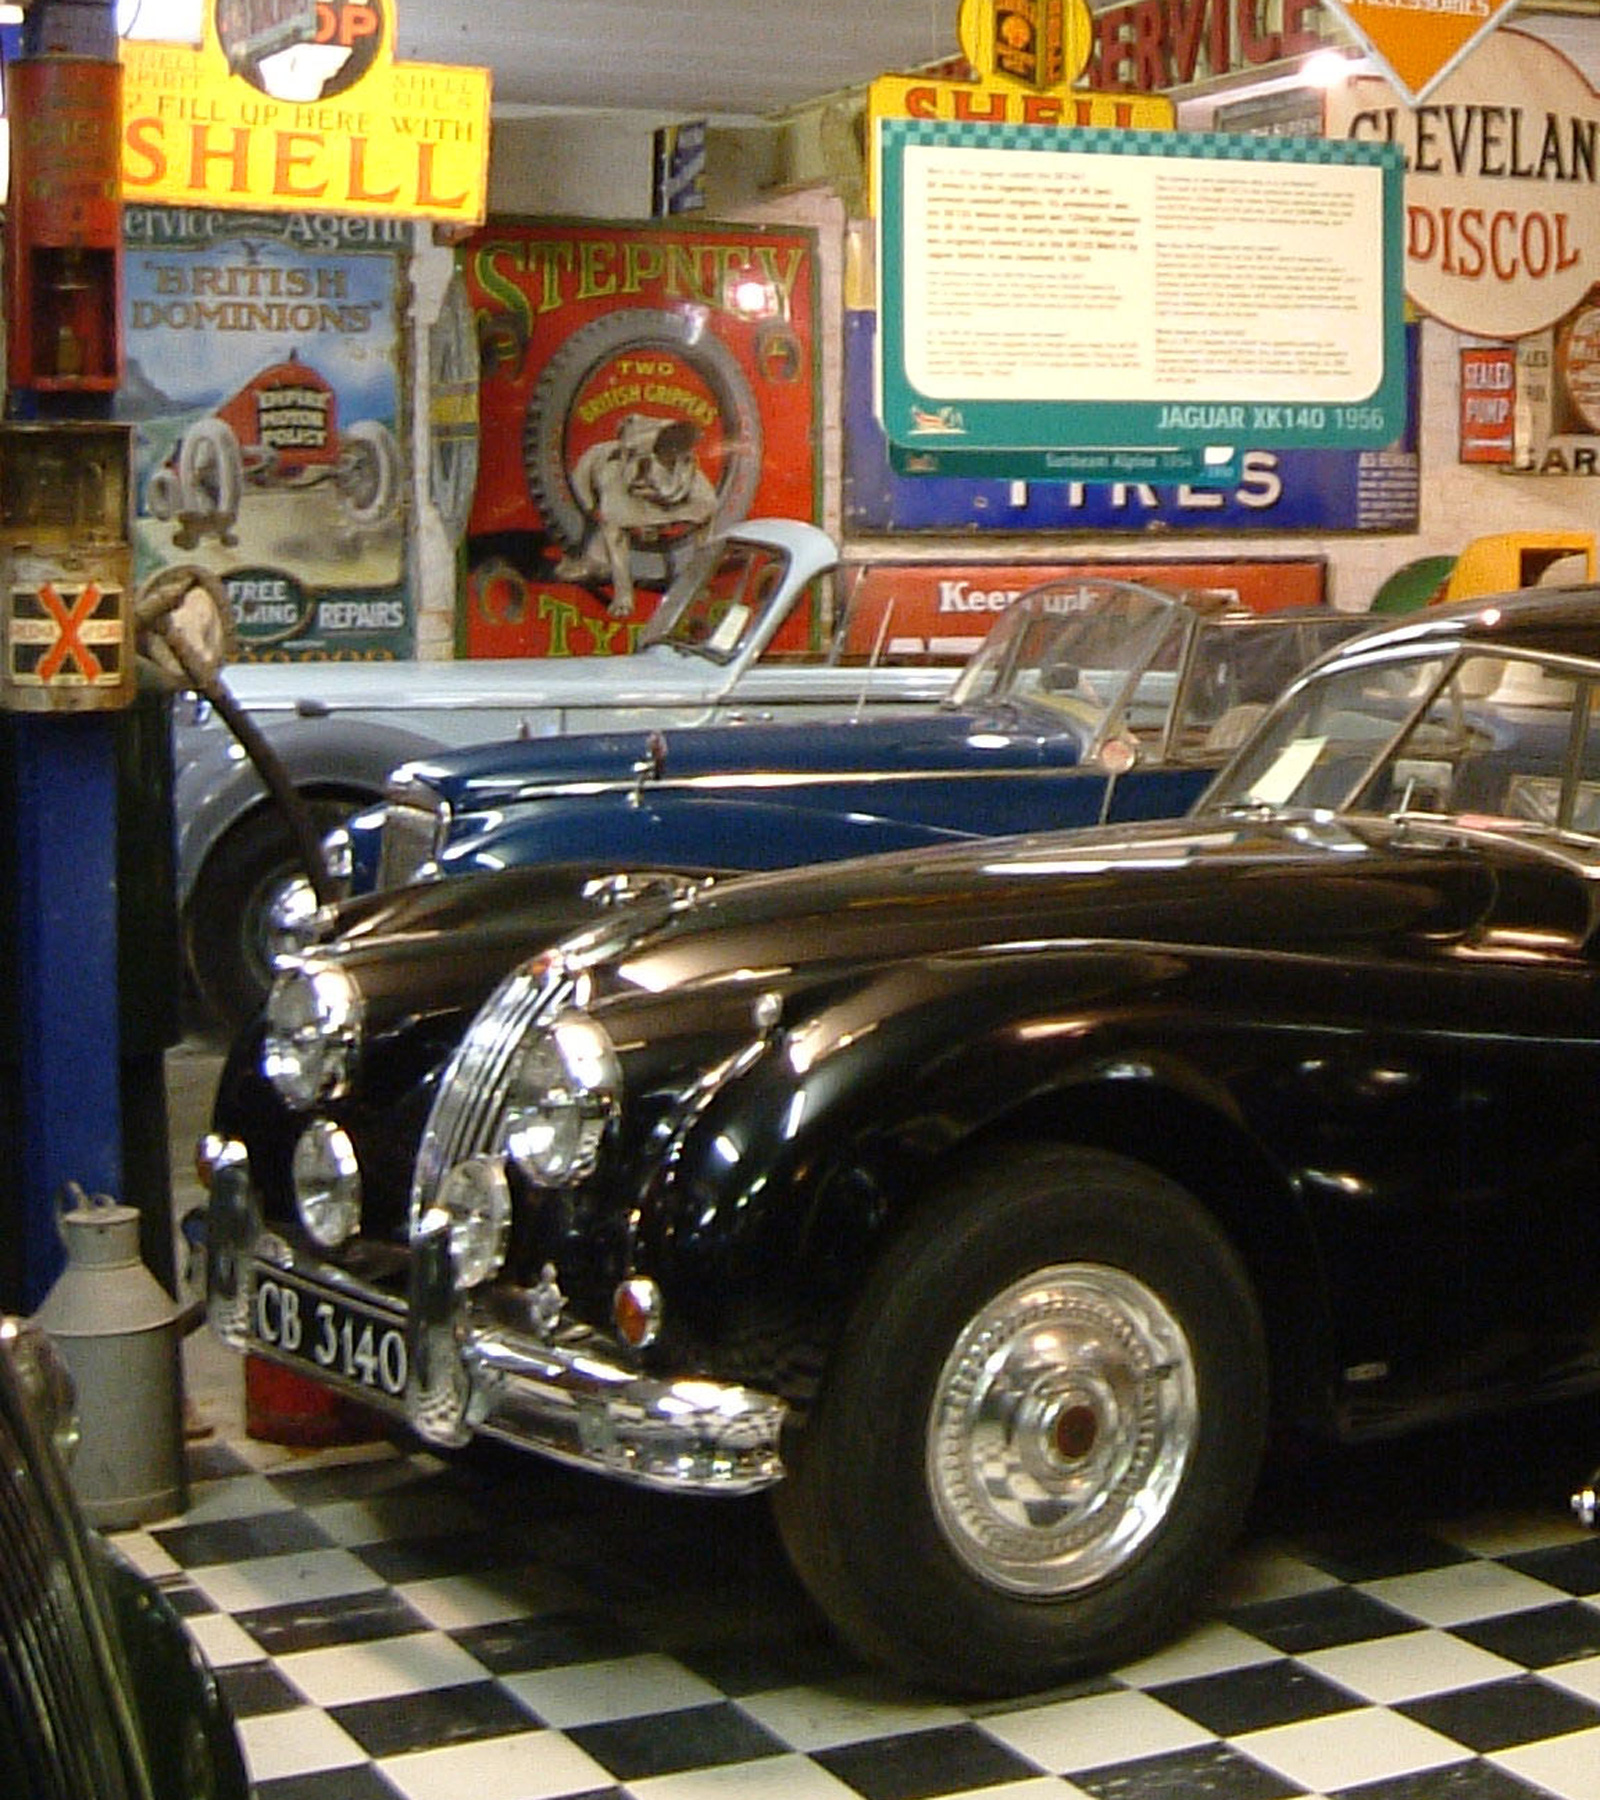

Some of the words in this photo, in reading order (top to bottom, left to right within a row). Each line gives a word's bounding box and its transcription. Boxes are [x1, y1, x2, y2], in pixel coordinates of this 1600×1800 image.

[1088, 0, 1325, 92] ERVICE
[158, 97, 226, 122] FILL
[240, 106, 279, 127] UP
[294, 108, 370, 133] HERE
[391, 115, 473, 142] WITH
[121, 116, 470, 208] SHELL
[124, 207, 226, 239] ervice
[1407, 204, 1581, 281] DISCOL
[473, 240, 804, 338] STEPNEY
[617, 359, 676, 376] TWO
[1157, 403, 1245, 430] JAGUAR
[1252, 406, 1326, 431] XK140
[1333, 407, 1385, 431] 1956
[228, 579, 288, 602] FREE
[318, 600, 405, 630] REPAIRS
[256, 1280, 301, 1352] CB
[313, 1303, 408, 1395] 3140
